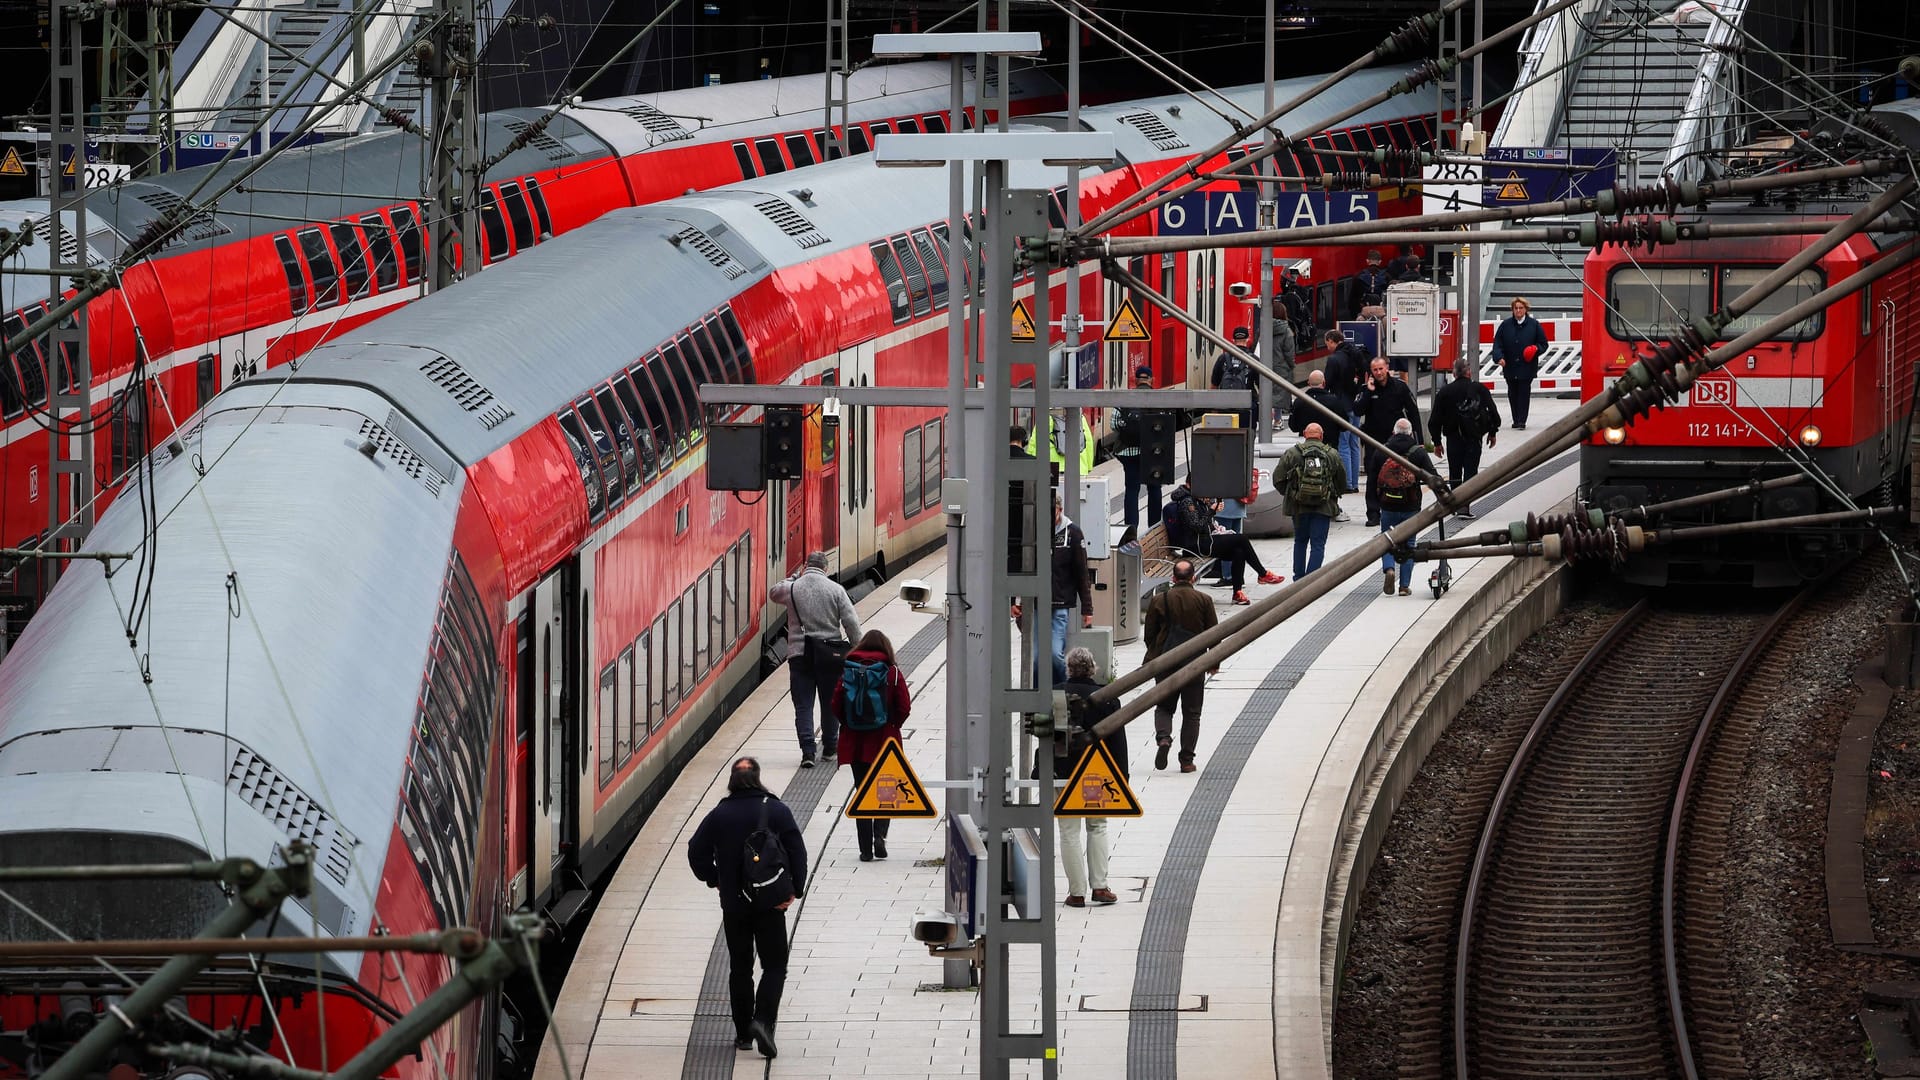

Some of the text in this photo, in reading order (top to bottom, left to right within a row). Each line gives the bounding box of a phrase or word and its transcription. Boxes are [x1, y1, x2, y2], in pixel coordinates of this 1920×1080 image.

[188, 135, 199, 147] S
[201, 135, 213, 147] U
[1499, 149, 1518, 160] 7-14
[1528, 150, 1536, 159] S
[1537, 149, 1545, 159] U
[1443, 190, 1461, 212] 4
[1163, 192, 1244, 229] 6 A
[1290, 193, 1370, 228] A 5
[1697, 382, 1729, 402] DB
[1688, 423, 1752, 437] 112 141-7
